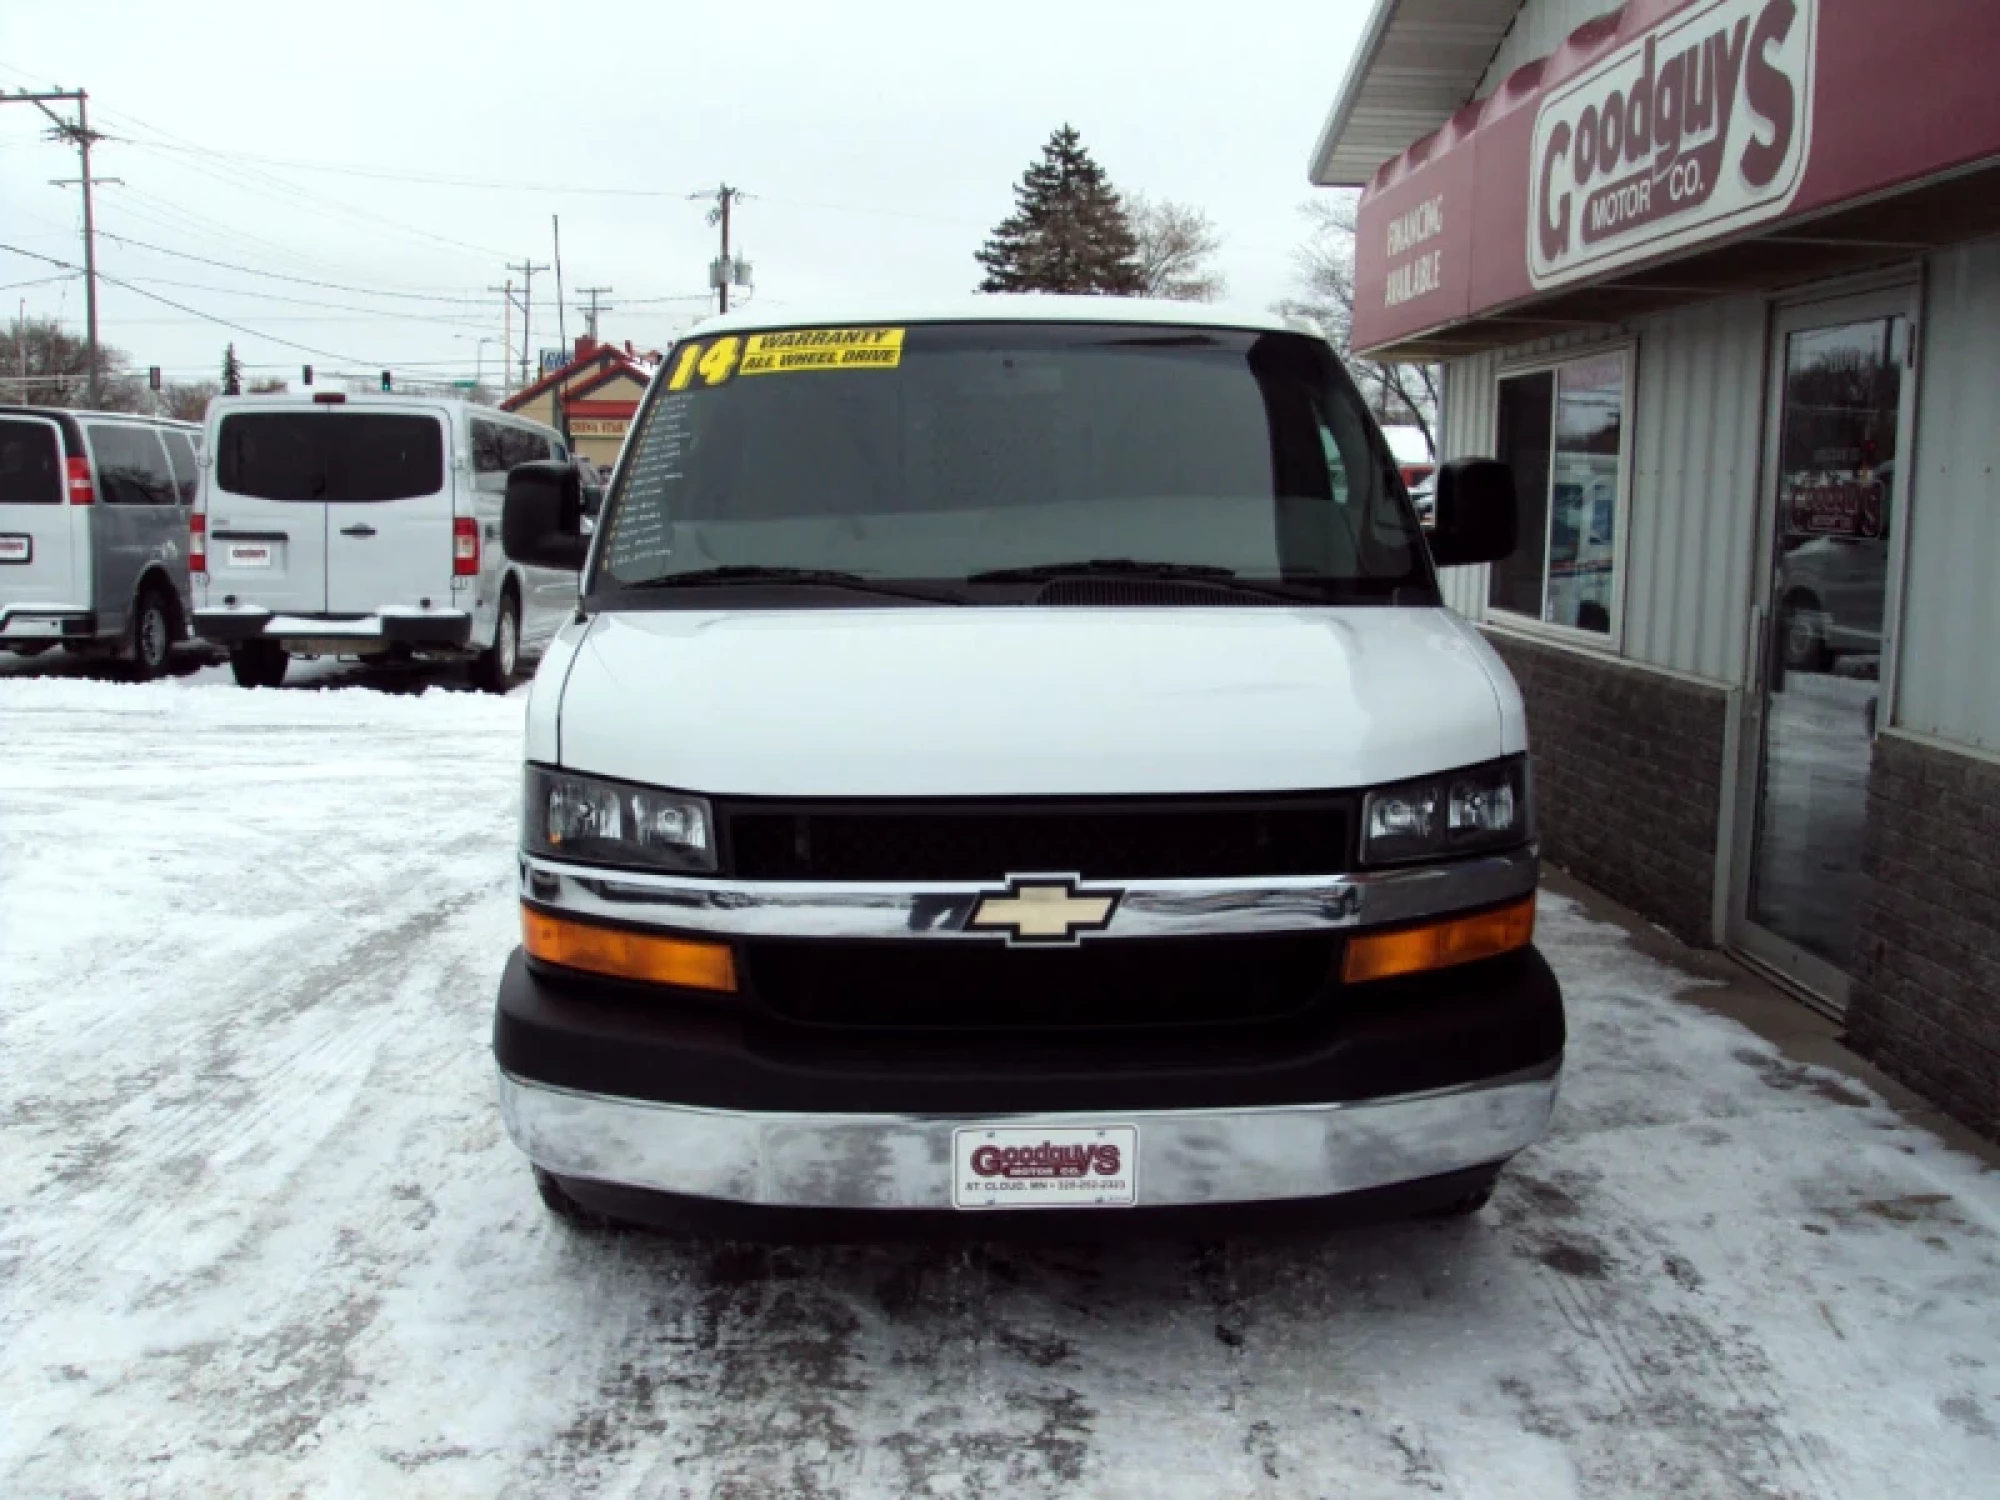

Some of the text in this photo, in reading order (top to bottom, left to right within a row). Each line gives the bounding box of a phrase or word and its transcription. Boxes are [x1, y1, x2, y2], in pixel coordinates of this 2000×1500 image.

[1591, 158, 1706, 231] MOTOR CO.
[1386, 192, 1444, 258] FINANCING
[1384, 250, 1441, 308] AVAILABLE
[667, 336, 740, 391] 14
[743, 349, 897, 370] ALL WHEEL DRIVE
[759, 329, 891, 350] WARRANTY
[1030, 1180, 1048, 1190] MN
